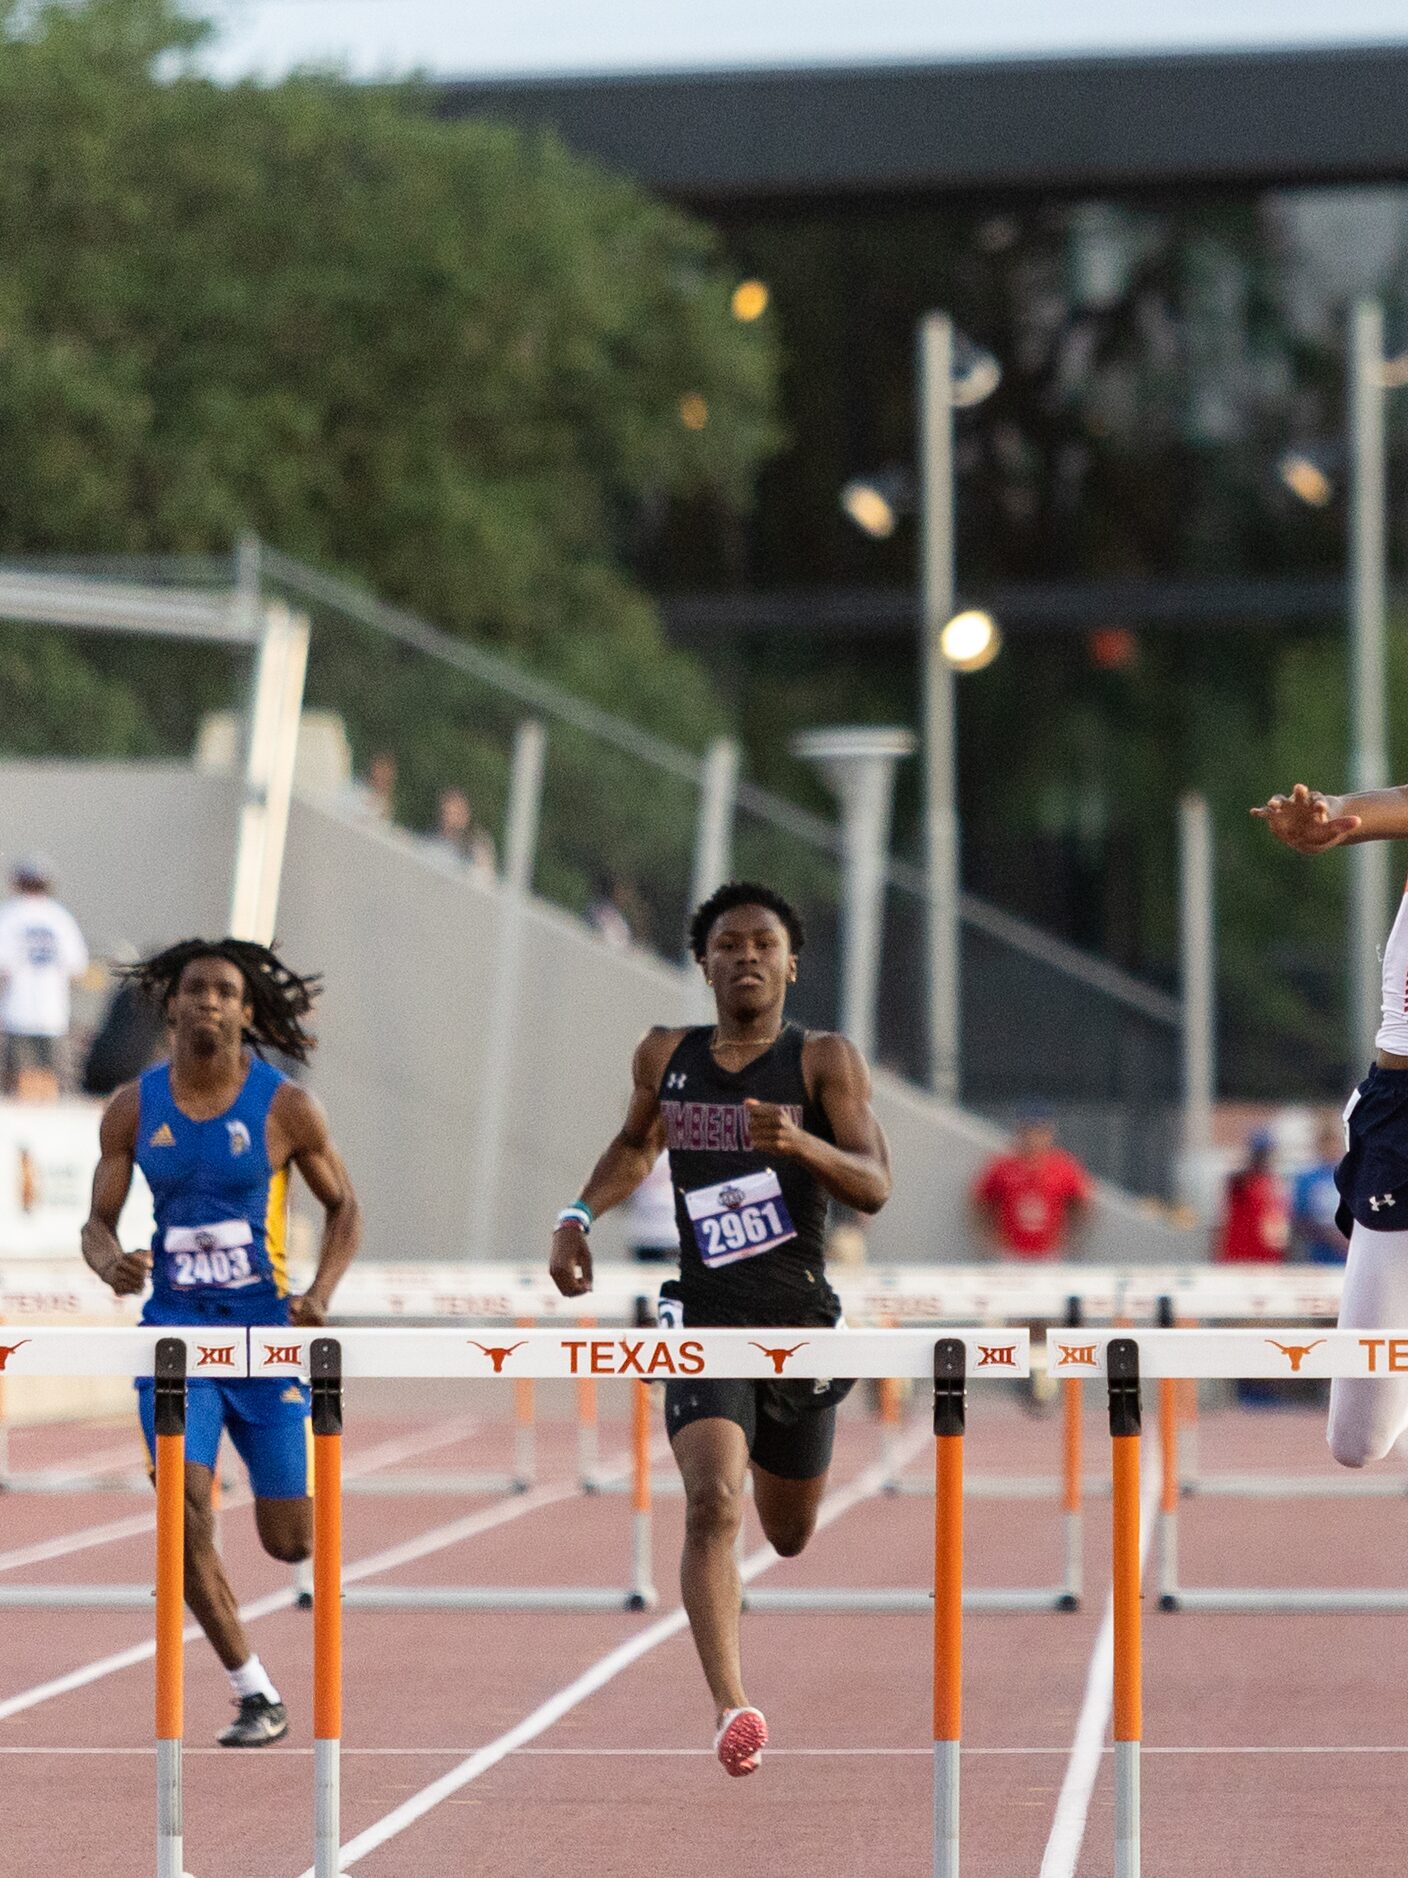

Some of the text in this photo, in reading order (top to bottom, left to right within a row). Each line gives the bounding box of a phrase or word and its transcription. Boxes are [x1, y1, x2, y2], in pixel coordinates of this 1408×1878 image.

[702, 1200, 784, 1256] 2961
[175, 1247, 252, 1286] 2403
[560, 1340, 706, 1375] TEXAS
